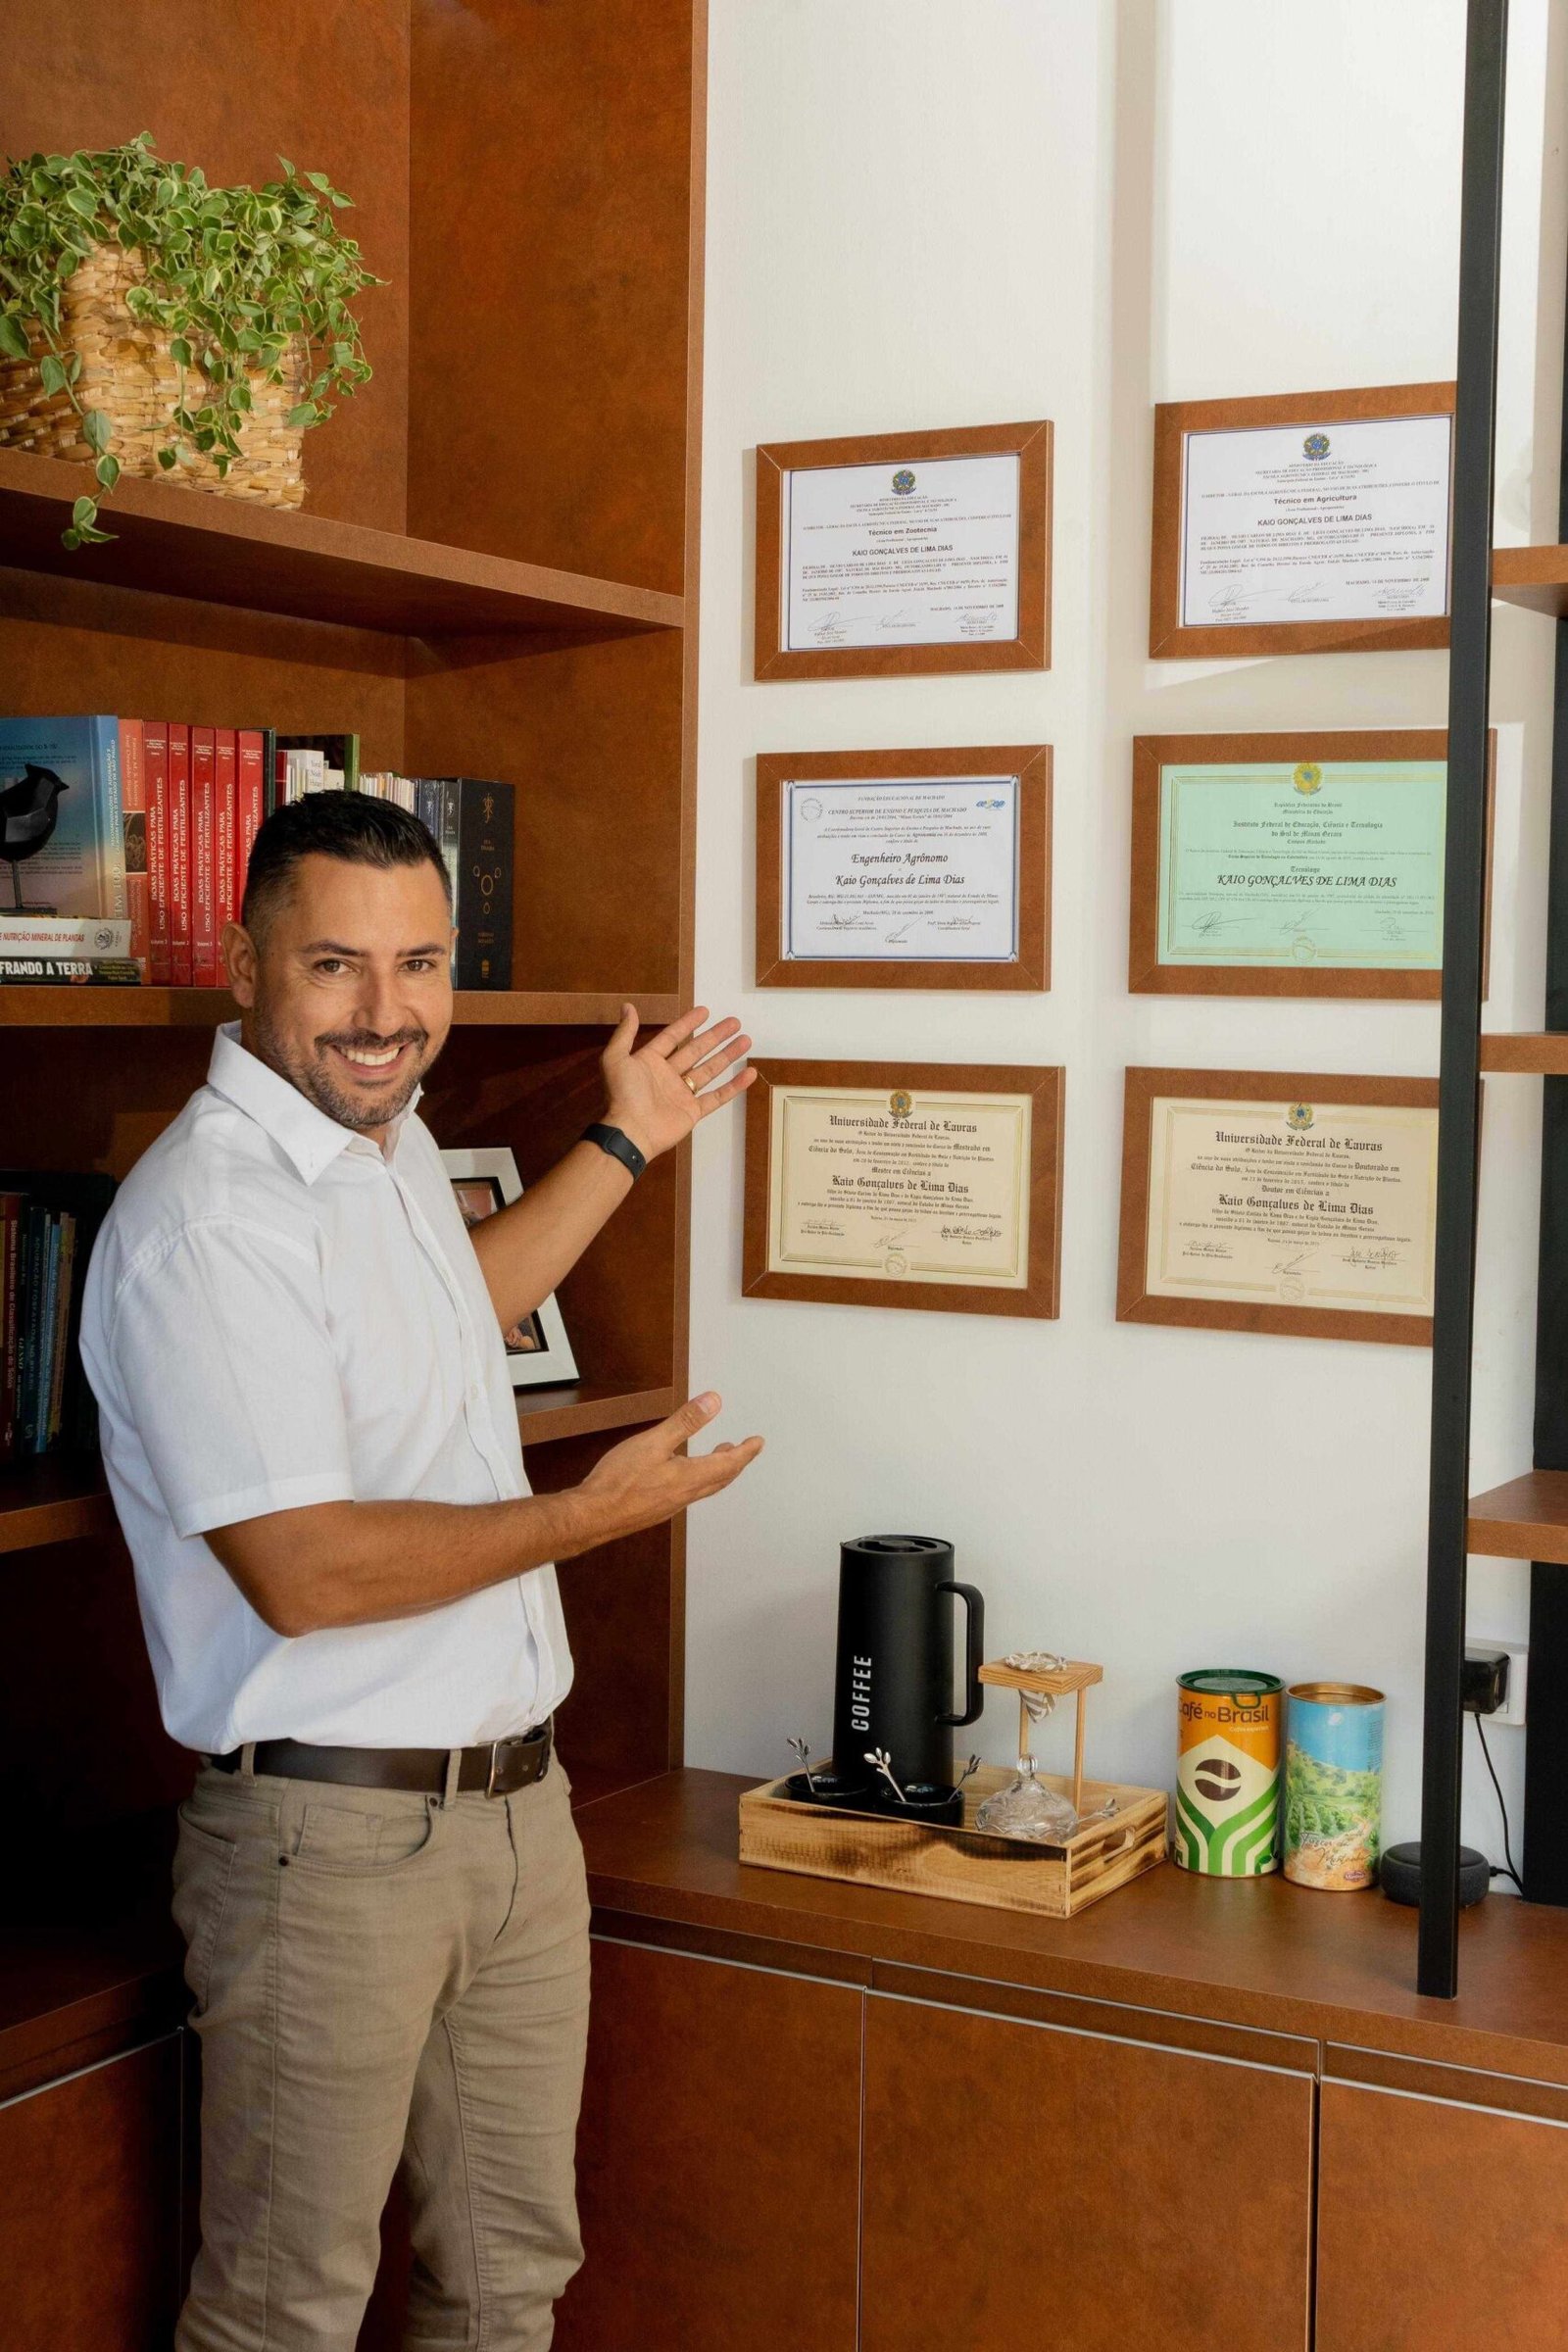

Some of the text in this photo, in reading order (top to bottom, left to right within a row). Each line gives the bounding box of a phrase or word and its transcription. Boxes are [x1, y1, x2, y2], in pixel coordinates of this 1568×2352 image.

[1316, 495, 1357, 504] Agricultura
[1277, 517, 1322, 526] GONÇALVES
[870, 547, 908, 556] GONÇALVES
[157, 847, 164, 860] DE
[179, 849, 186, 861] DE
[204, 851, 211, 863] DE
[226, 851, 232, 863] DE
[851, 852, 949, 866] Engenheiro Agrônomo
[835, 874, 964, 888] Kaio Gonçalves de Lima Dias
[1217, 874, 1397, 888] KAIO GONÇALVES DE LIMA DIAS
[46, 961, 55, 975] A
[56, 961, 93, 975] TERRA
[830, 1115, 977, 1133] Universidade Federal de Lavras
[1215, 1131, 1383, 1152] Universidade Federal de Lavras
[832, 1175, 969, 1193] Kaio Gonçalves de Lima Dias
[1219, 1194, 1373, 1215] Kaio Gonçalves de Lima Dias
[9, 1291, 15, 1301] de
[7, 1303, 16, 1354] Classificação
[7, 1356, 15, 1365] de
[851, 1655, 871, 1732] COFFEE
[1204, 1710, 1216, 1719] no
[1217, 1705, 1269, 1723] Brasil
